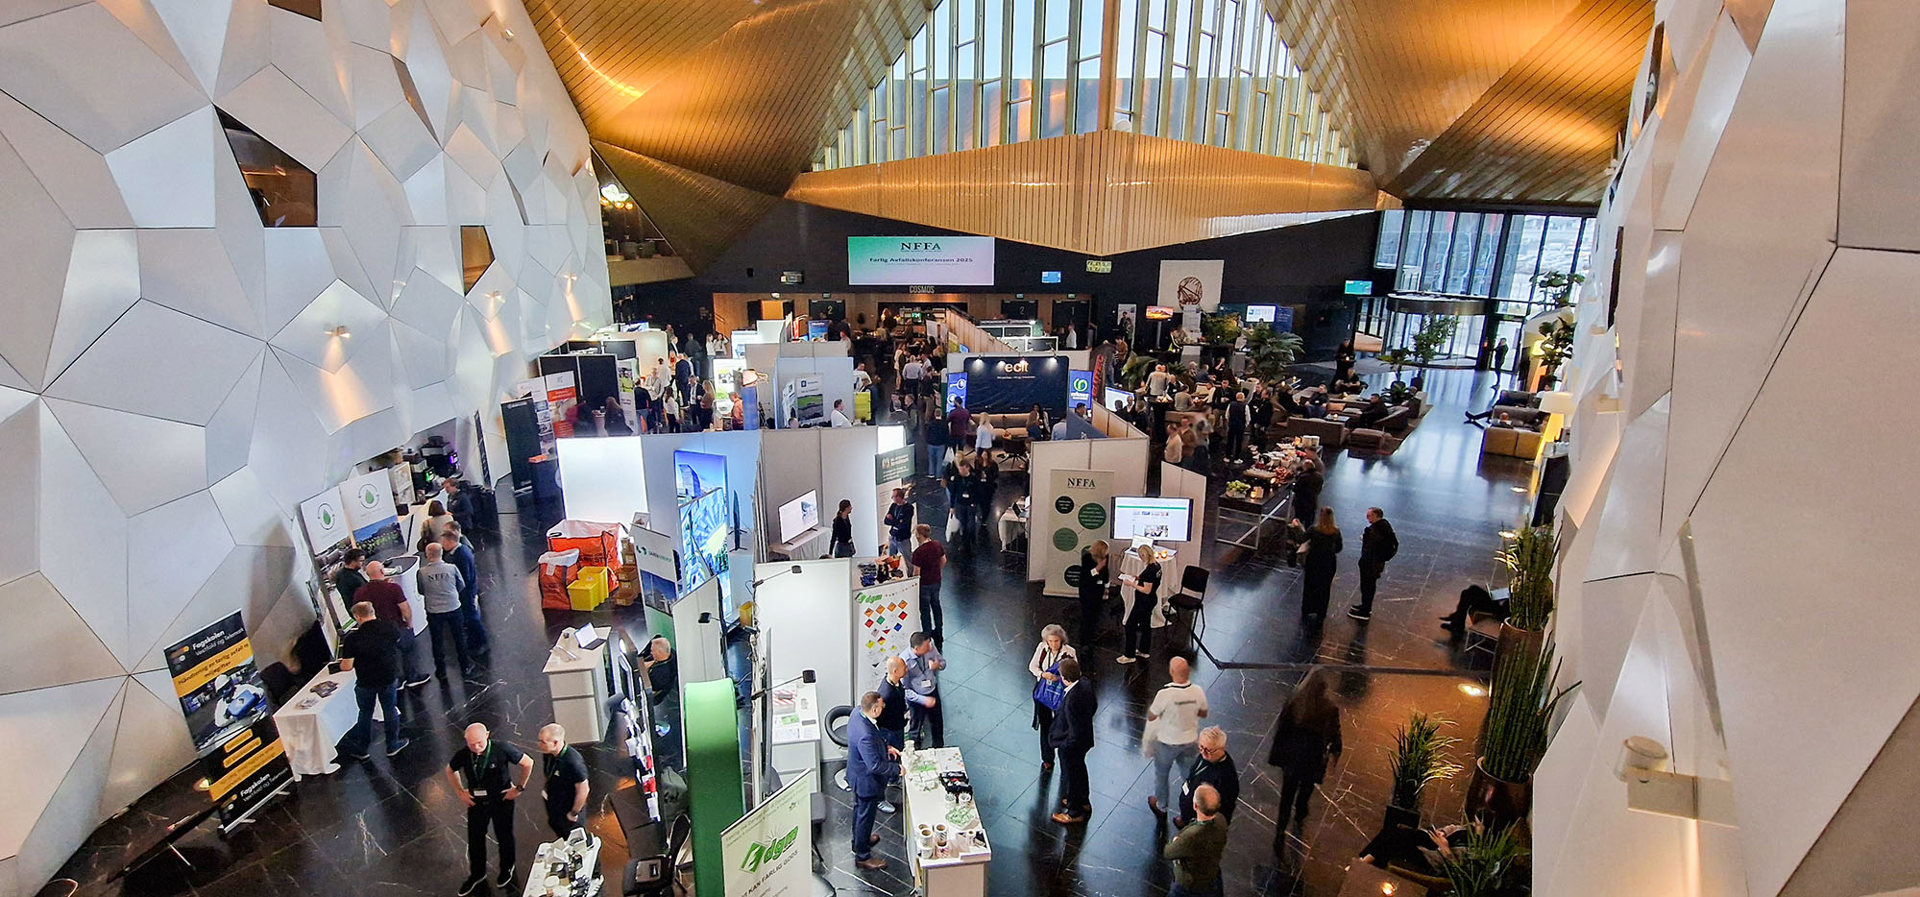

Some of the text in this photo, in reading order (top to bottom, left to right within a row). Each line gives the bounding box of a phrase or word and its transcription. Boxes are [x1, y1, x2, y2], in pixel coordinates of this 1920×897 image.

[900, 242, 941, 250] NFFA
[909, 286, 935, 294] COSMOS
[828, 305, 833, 314] 2
[1019, 306, 1025, 315] 2
[1004, 361, 1029, 373] ecit
[1068, 478, 1095, 488] NFFA
[428, 572, 450, 582] NFFA
[192, 630, 225, 651] Fagskolen
[195, 641, 217, 656] Vestfold
[224, 627, 244, 641] Telemark
[240, 773, 271, 797] Fagskolen
[748, 880, 761, 893] KAN
[761, 864, 782, 882] FARLIG
